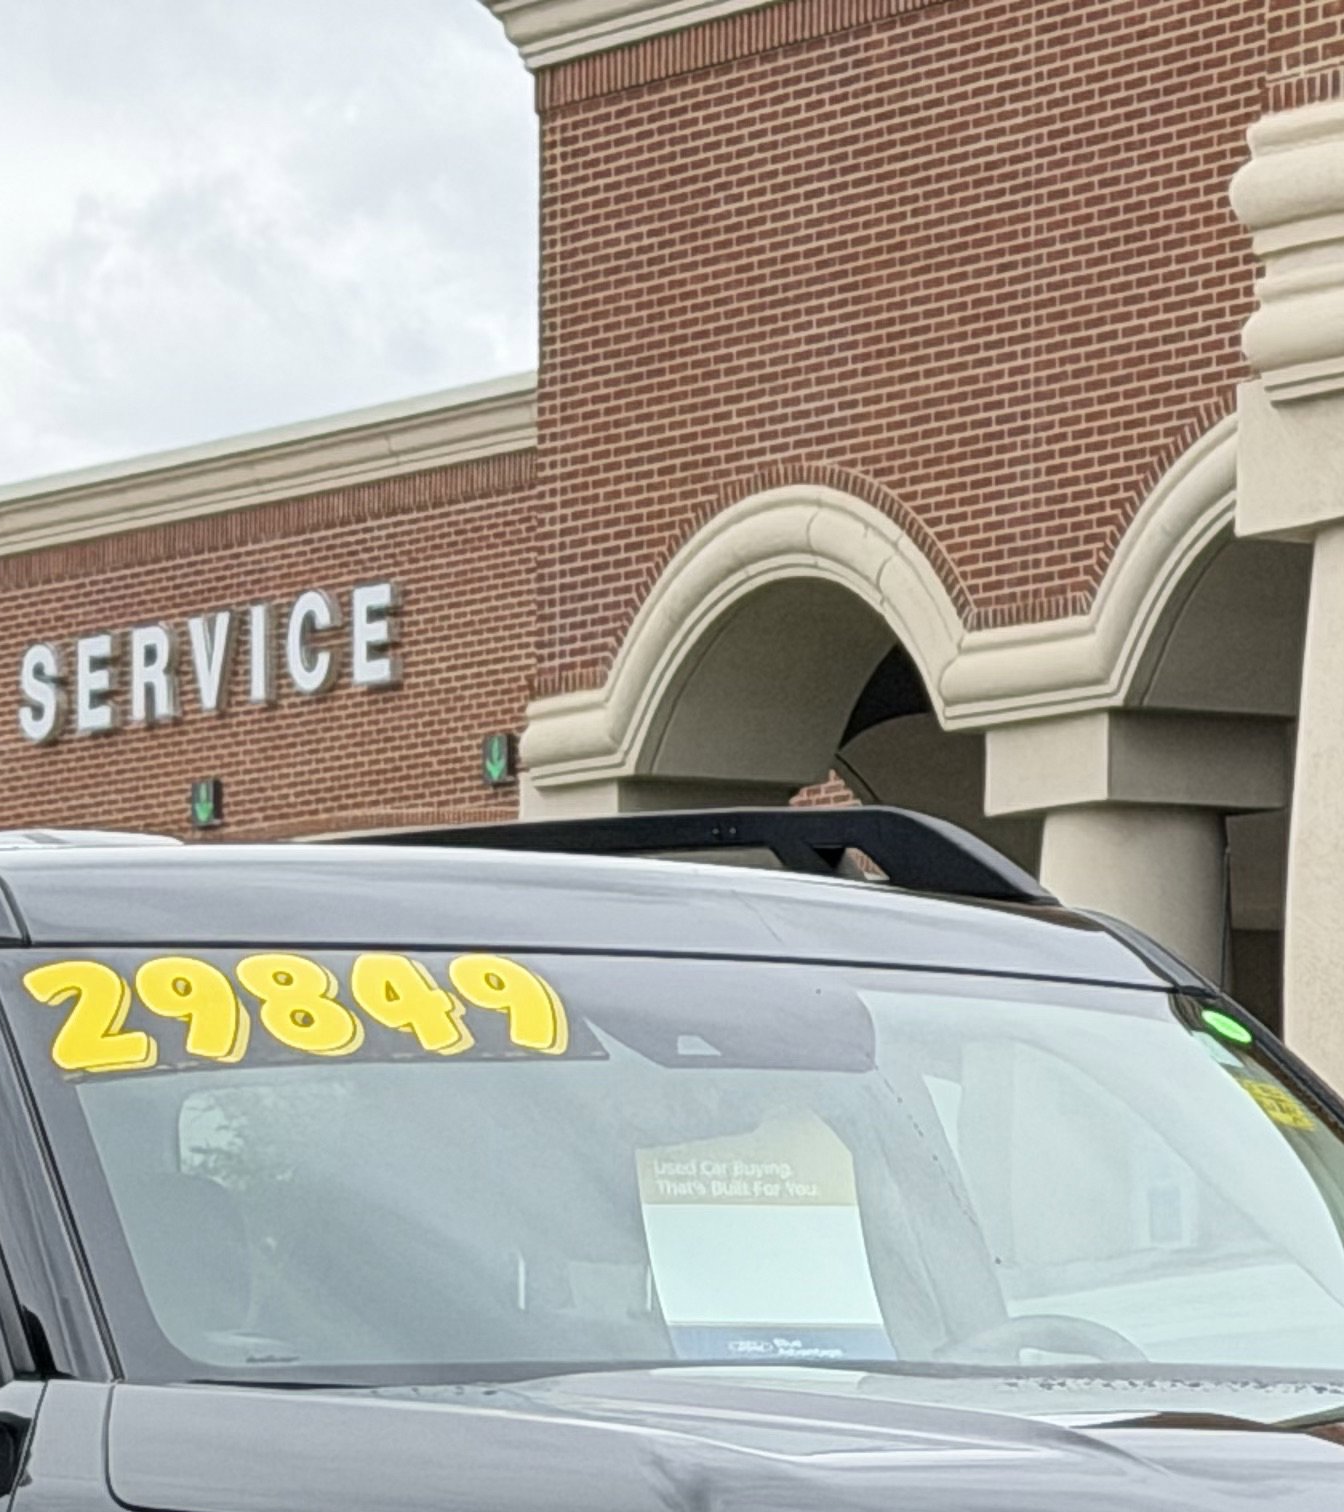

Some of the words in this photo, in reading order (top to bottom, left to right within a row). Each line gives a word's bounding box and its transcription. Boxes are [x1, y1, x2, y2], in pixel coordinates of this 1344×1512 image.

[19, 581, 398, 744] SERVICE
[23, 952, 568, 1072] 29849
[654, 1159, 697, 1177] Used
[701, 1161, 729, 1178] Car
[754, 1180, 781, 1198] For
